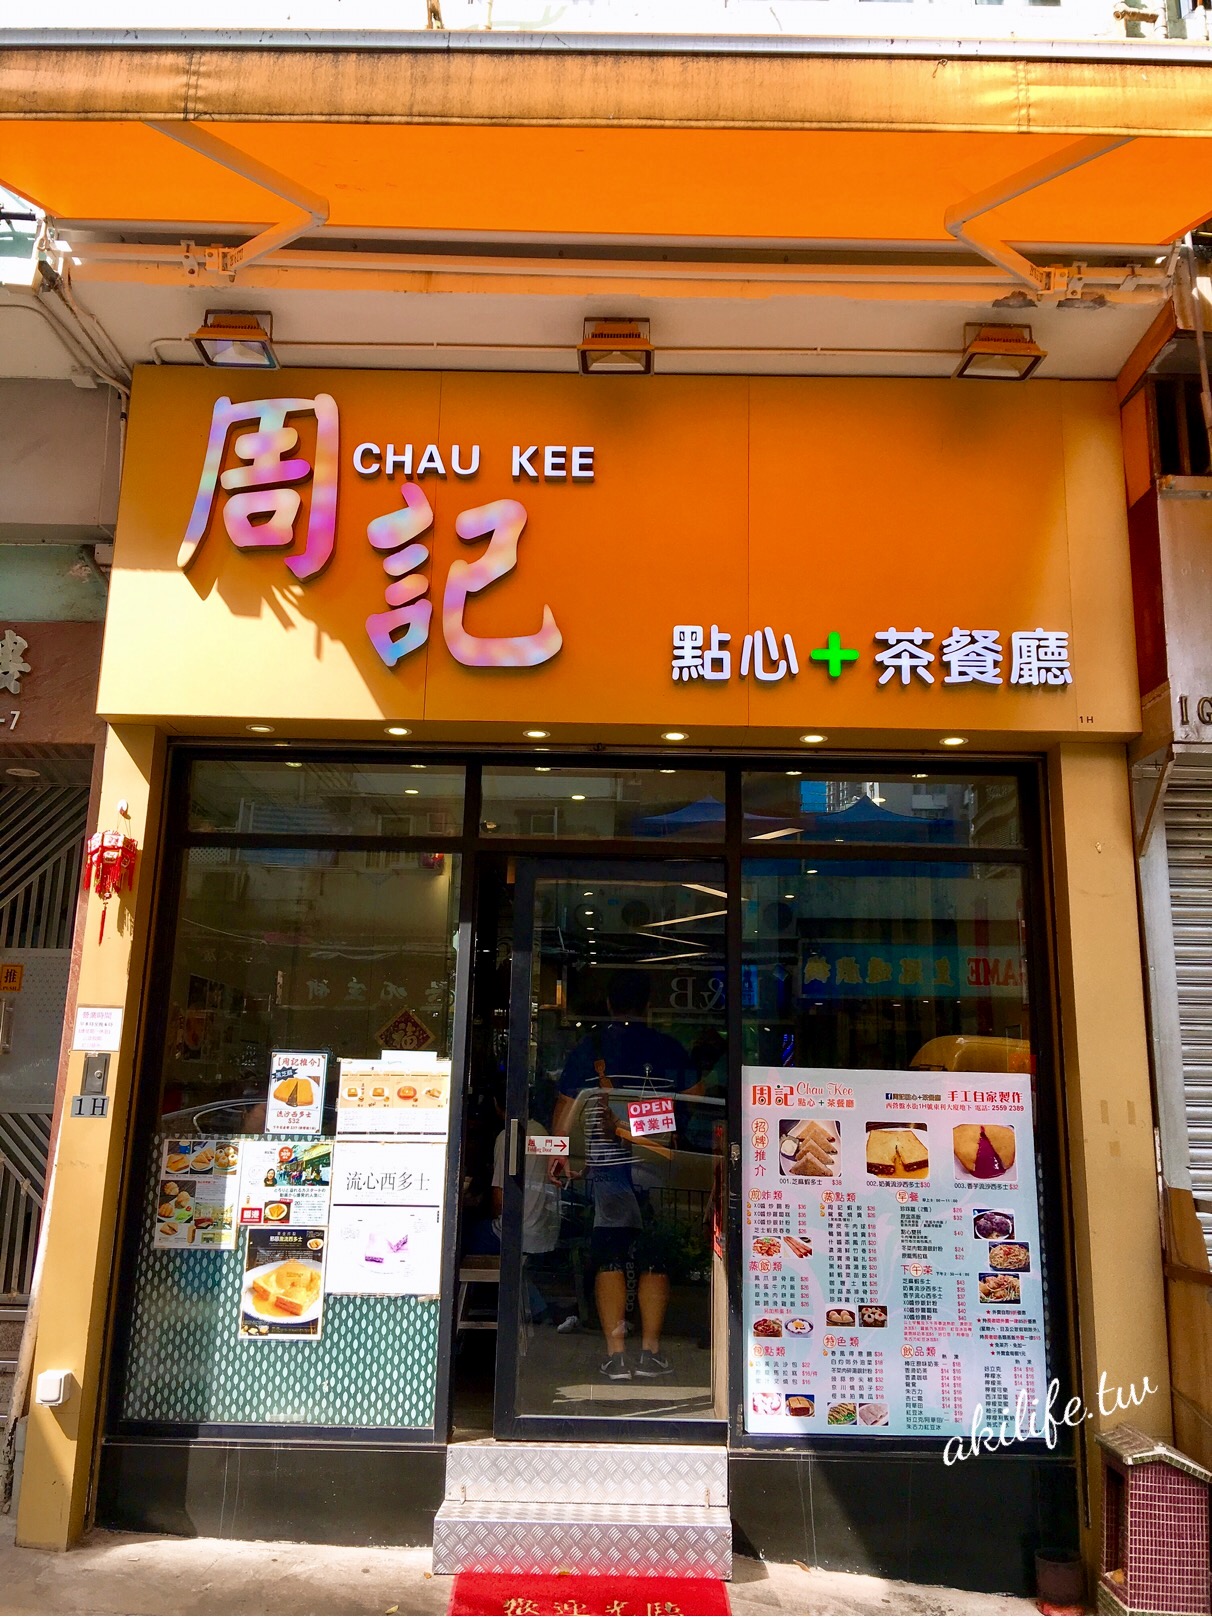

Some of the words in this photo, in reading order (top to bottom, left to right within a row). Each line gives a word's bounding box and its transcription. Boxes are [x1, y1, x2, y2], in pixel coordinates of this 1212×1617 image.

[352, 442, 481, 477] CHAU
[511, 445, 595, 479] KEE
[4, 968, 18, 984] 推
[752, 1084, 794, 1106] 周記
[796, 1081, 823, 1095] Chau
[827, 1082, 853, 1096] Kee
[948, 1090, 1023, 1103] 手工自家製作
[630, 1100, 673, 1116] OPEN
[633, 1116, 674, 1133] 營業中
[754, 1121, 767, 1176] 招牌推介
[346, 1171, 430, 1191] 流心西多士
[750, 1189, 783, 1201] 煎炸類
[823, 1191, 856, 1203] 蒸點類
[897, 1191, 919, 1203] 早餐
[749, 1260, 783, 1272] 蒸飯類
[900, 1264, 933, 1276] 下午茶
[825, 1336, 859, 1348] 特色類
[902, 1346, 936, 1358] 飲品類
